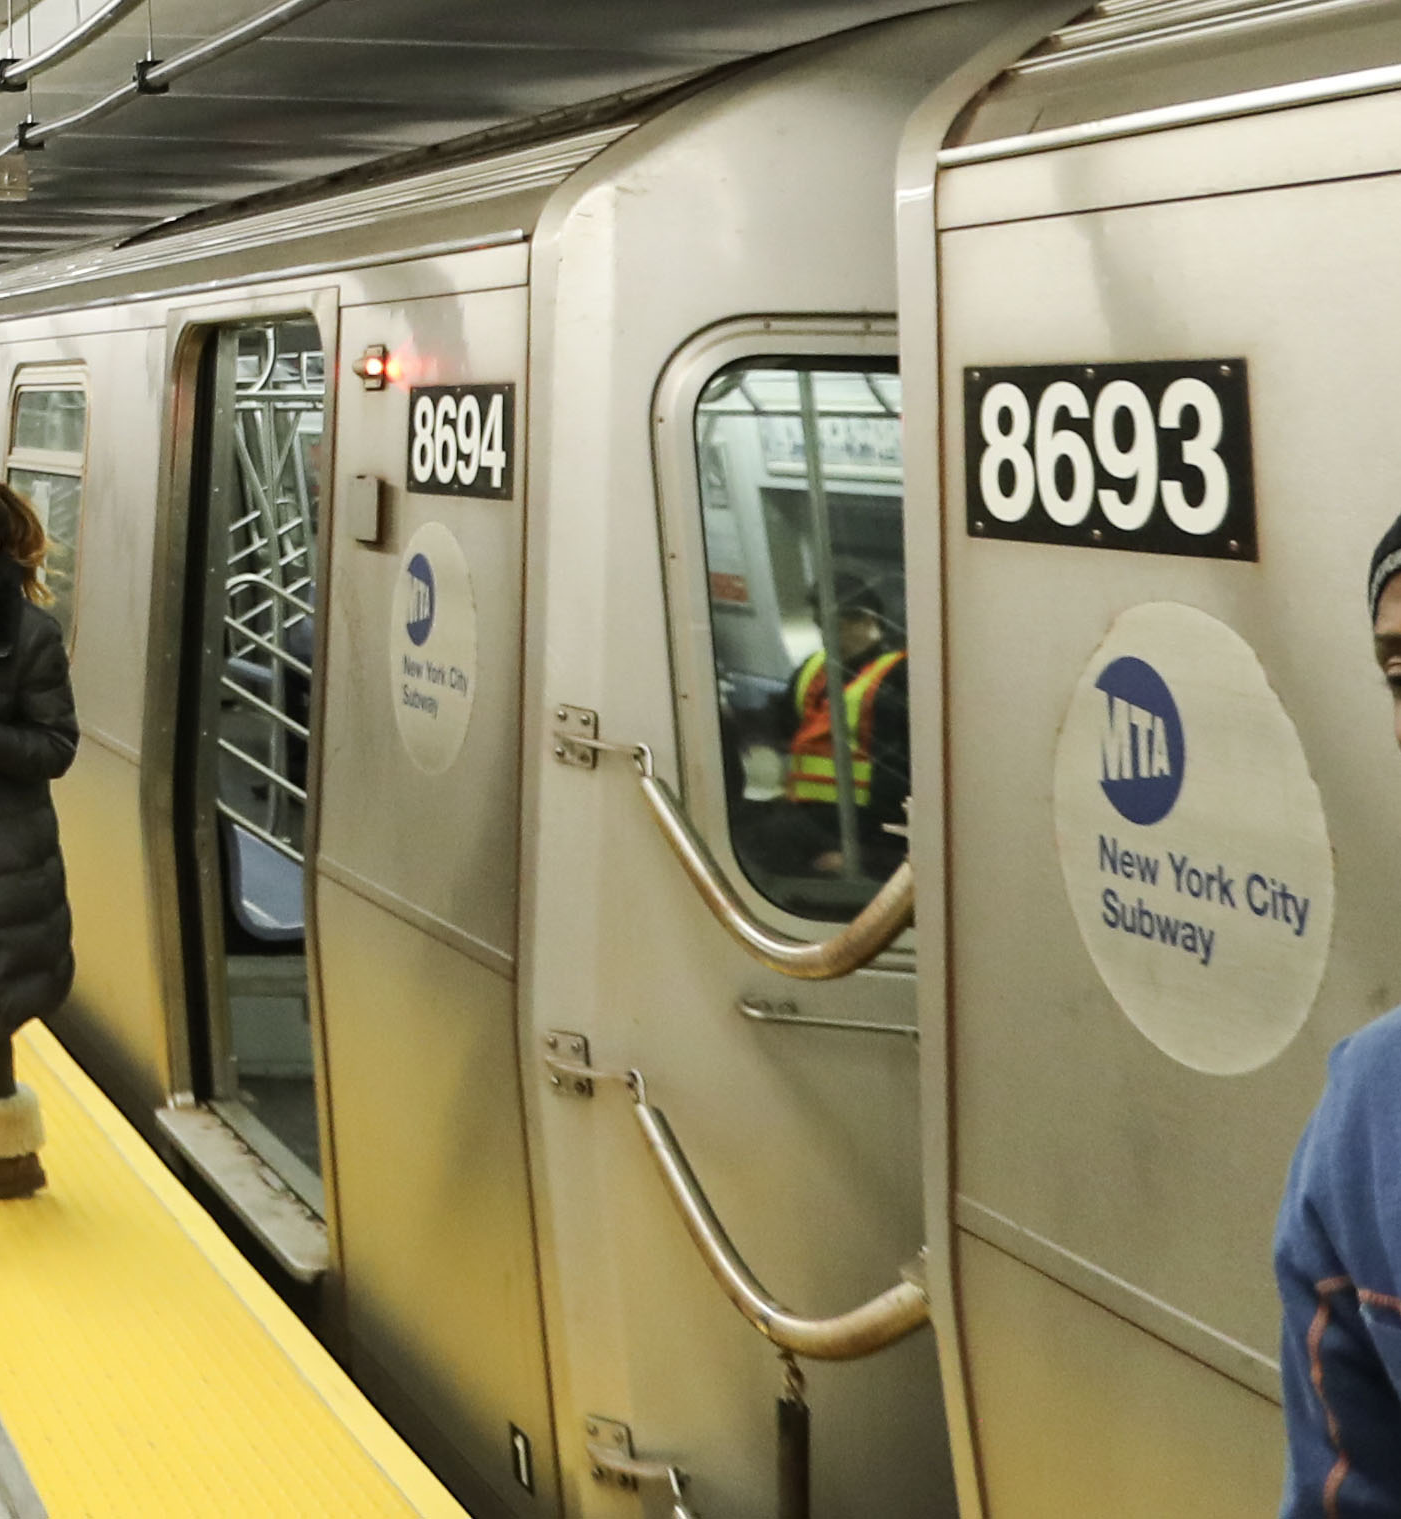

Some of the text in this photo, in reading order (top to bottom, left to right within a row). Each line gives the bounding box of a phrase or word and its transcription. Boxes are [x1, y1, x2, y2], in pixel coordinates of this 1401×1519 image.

[411, 393, 506, 489] 8694
[979, 377, 1230, 535] 8693
[402, 683, 438, 720] Subway
[404, 654, 467, 697] New York City
[1096, 686, 1172, 781] MTA
[1098, 834, 1310, 937] New York City
[1102, 888, 1215, 968] Subway
